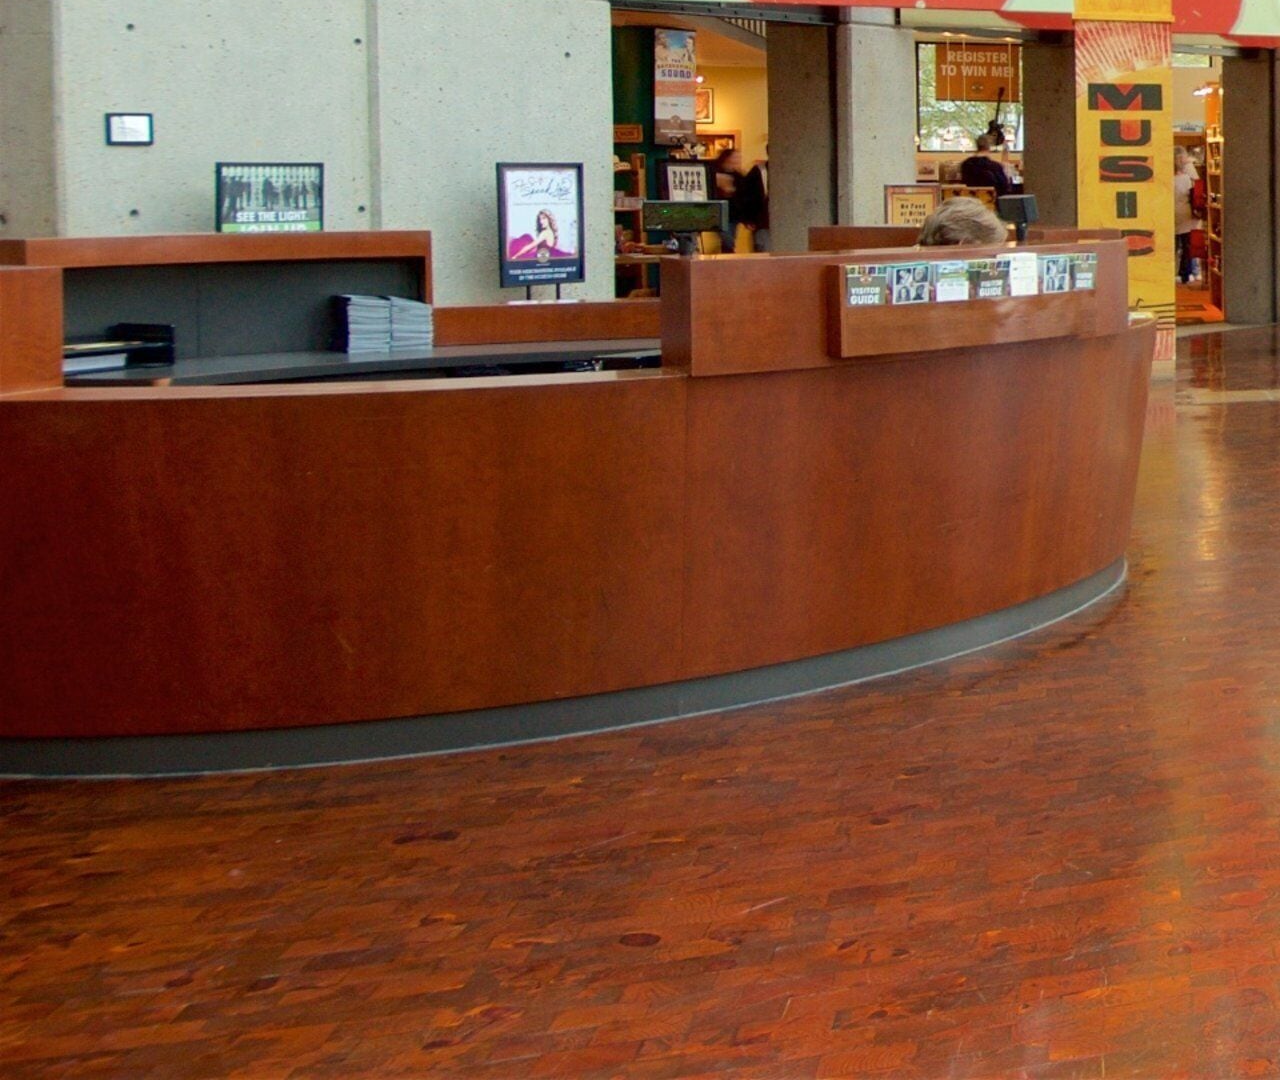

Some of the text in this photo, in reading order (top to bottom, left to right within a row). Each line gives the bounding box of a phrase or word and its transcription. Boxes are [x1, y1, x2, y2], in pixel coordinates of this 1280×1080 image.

[947, 50, 1008, 63] REGISTER
[661, 69, 691, 79] SOUND
[940, 64, 1014, 78] TO WIN ME!
[1088, 83, 1163, 257] MUSIC
[236, 212, 256, 222] SEE
[258, 211, 277, 221] THE
[850, 286, 881, 294] VISITOR
[850, 294, 881, 305] GUIDE
